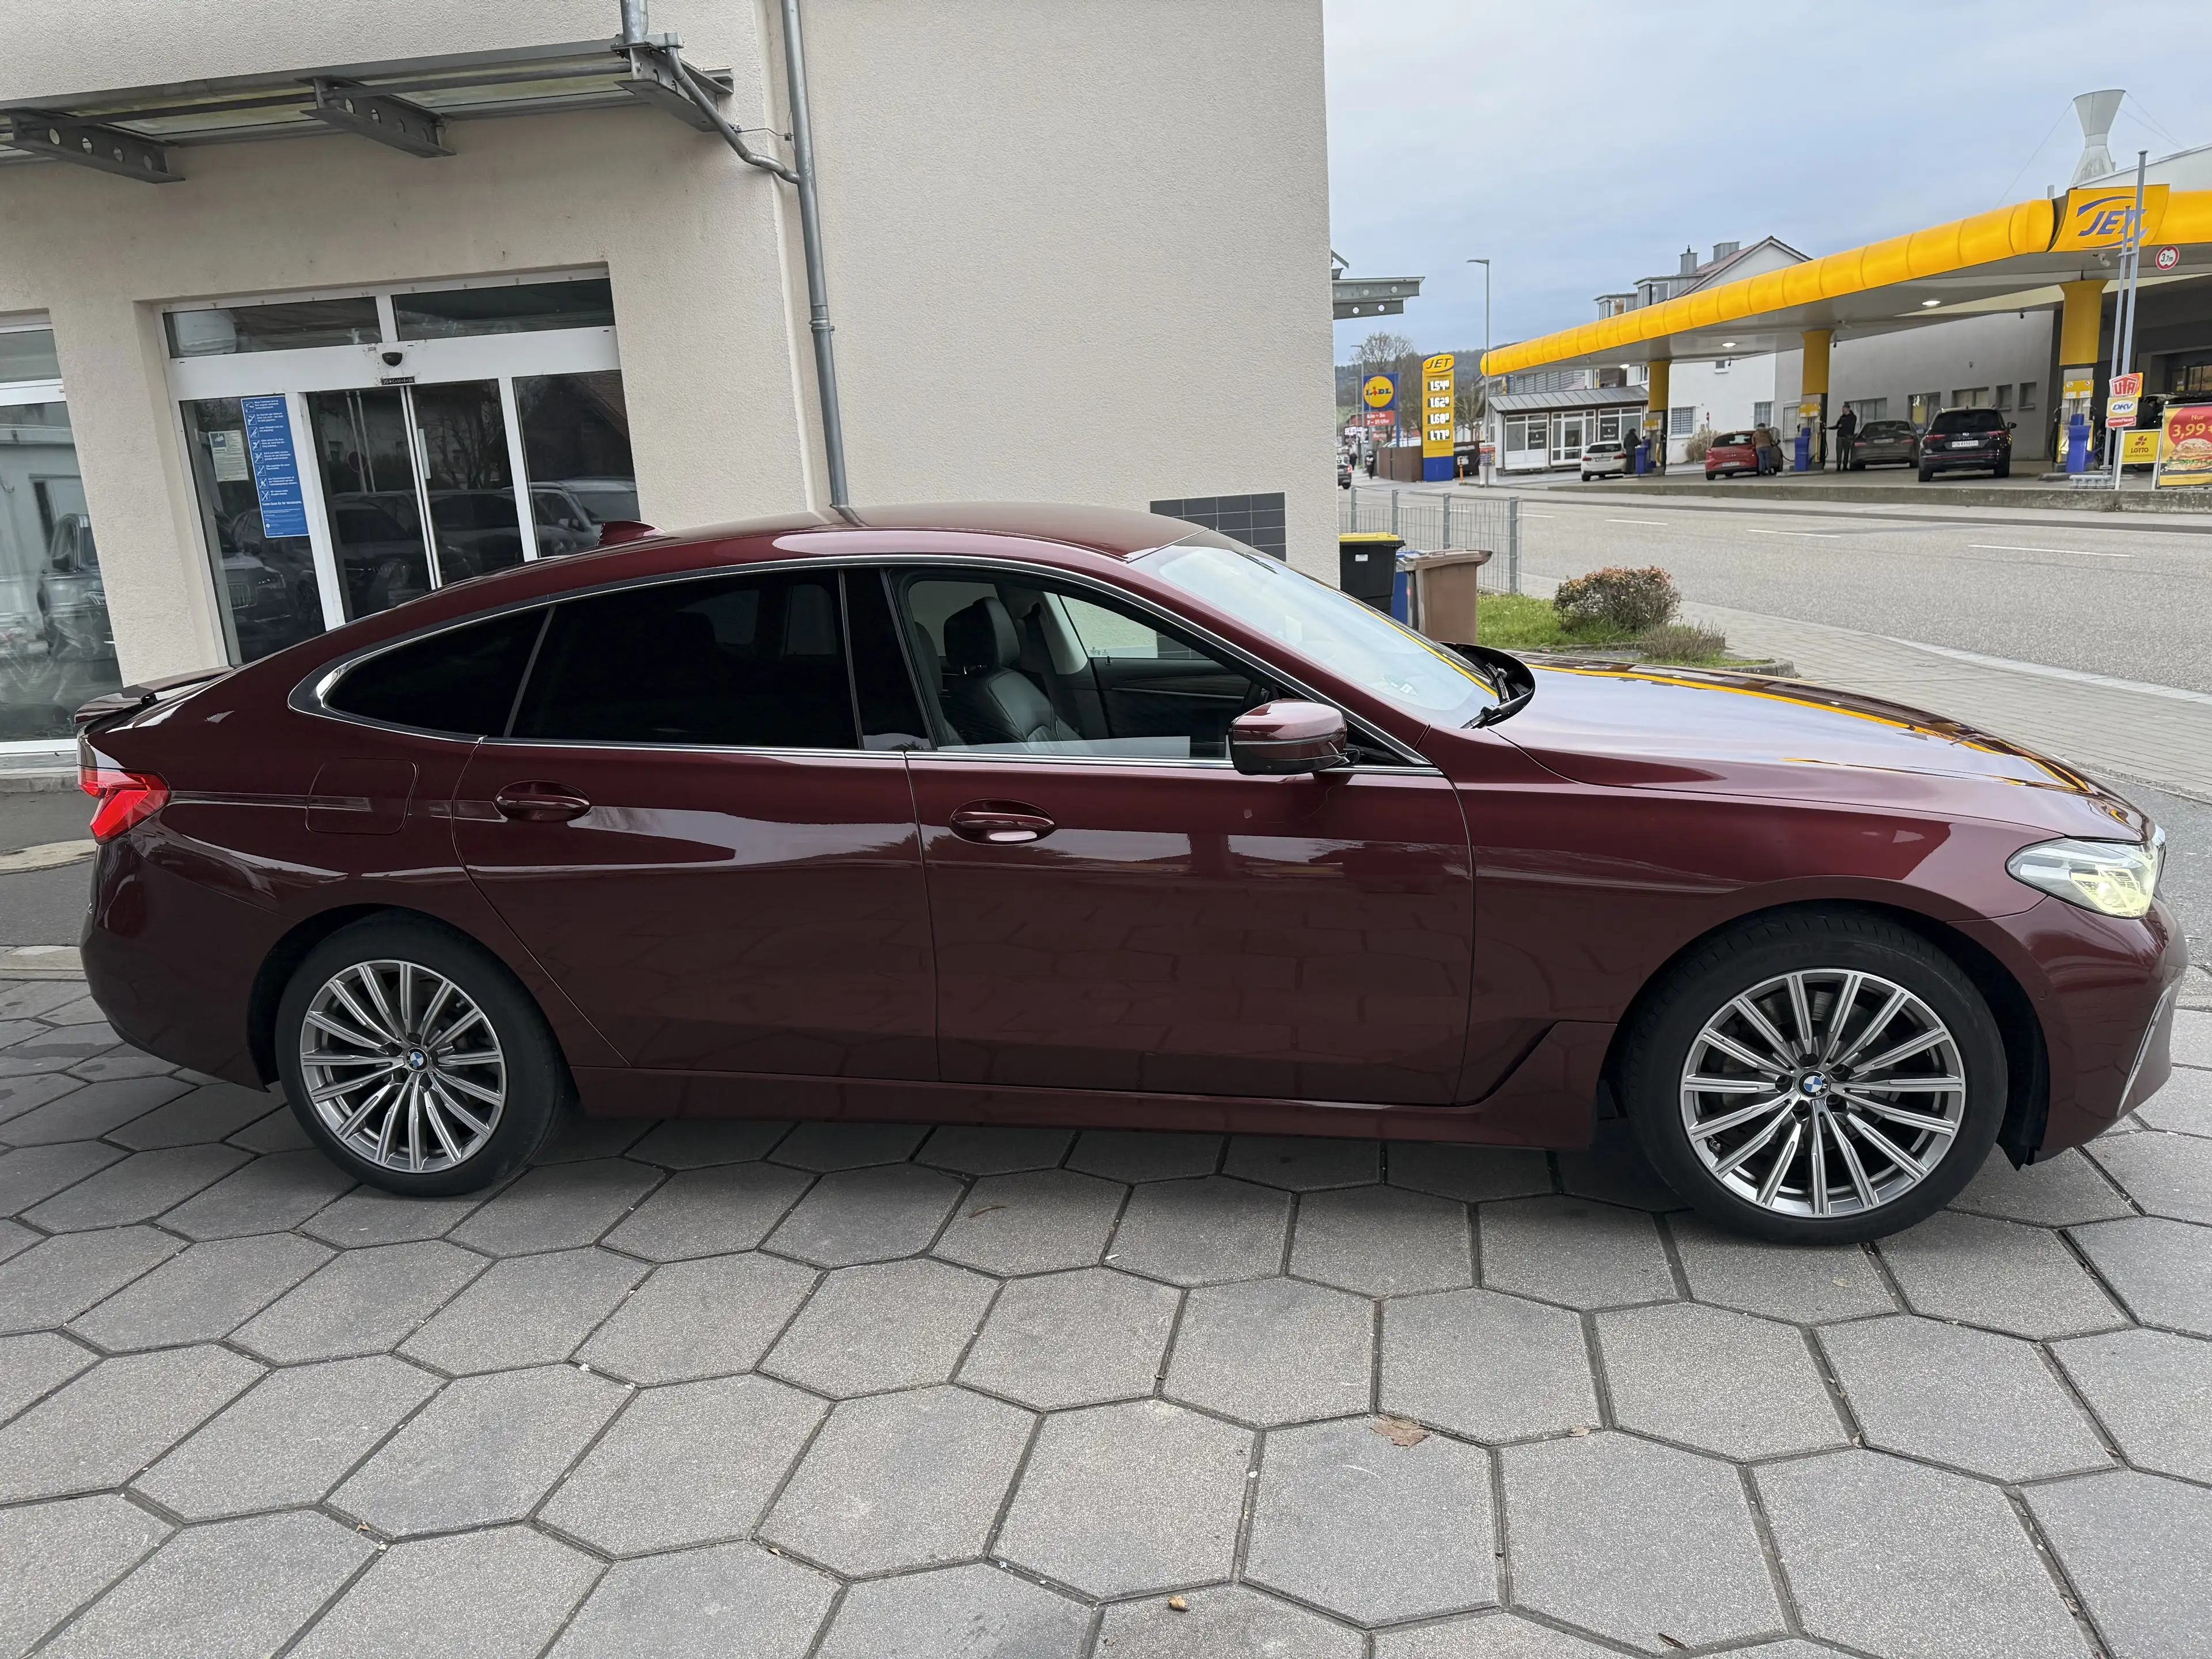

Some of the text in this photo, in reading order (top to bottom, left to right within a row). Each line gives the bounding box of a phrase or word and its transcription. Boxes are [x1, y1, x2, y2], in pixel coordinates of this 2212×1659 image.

[1426, 358, 1451, 369] JET
[1366, 386, 1392, 396] LIDL
[2114, 381, 2136, 395] UTA
[2172, 423, 2206, 440] 3,99
